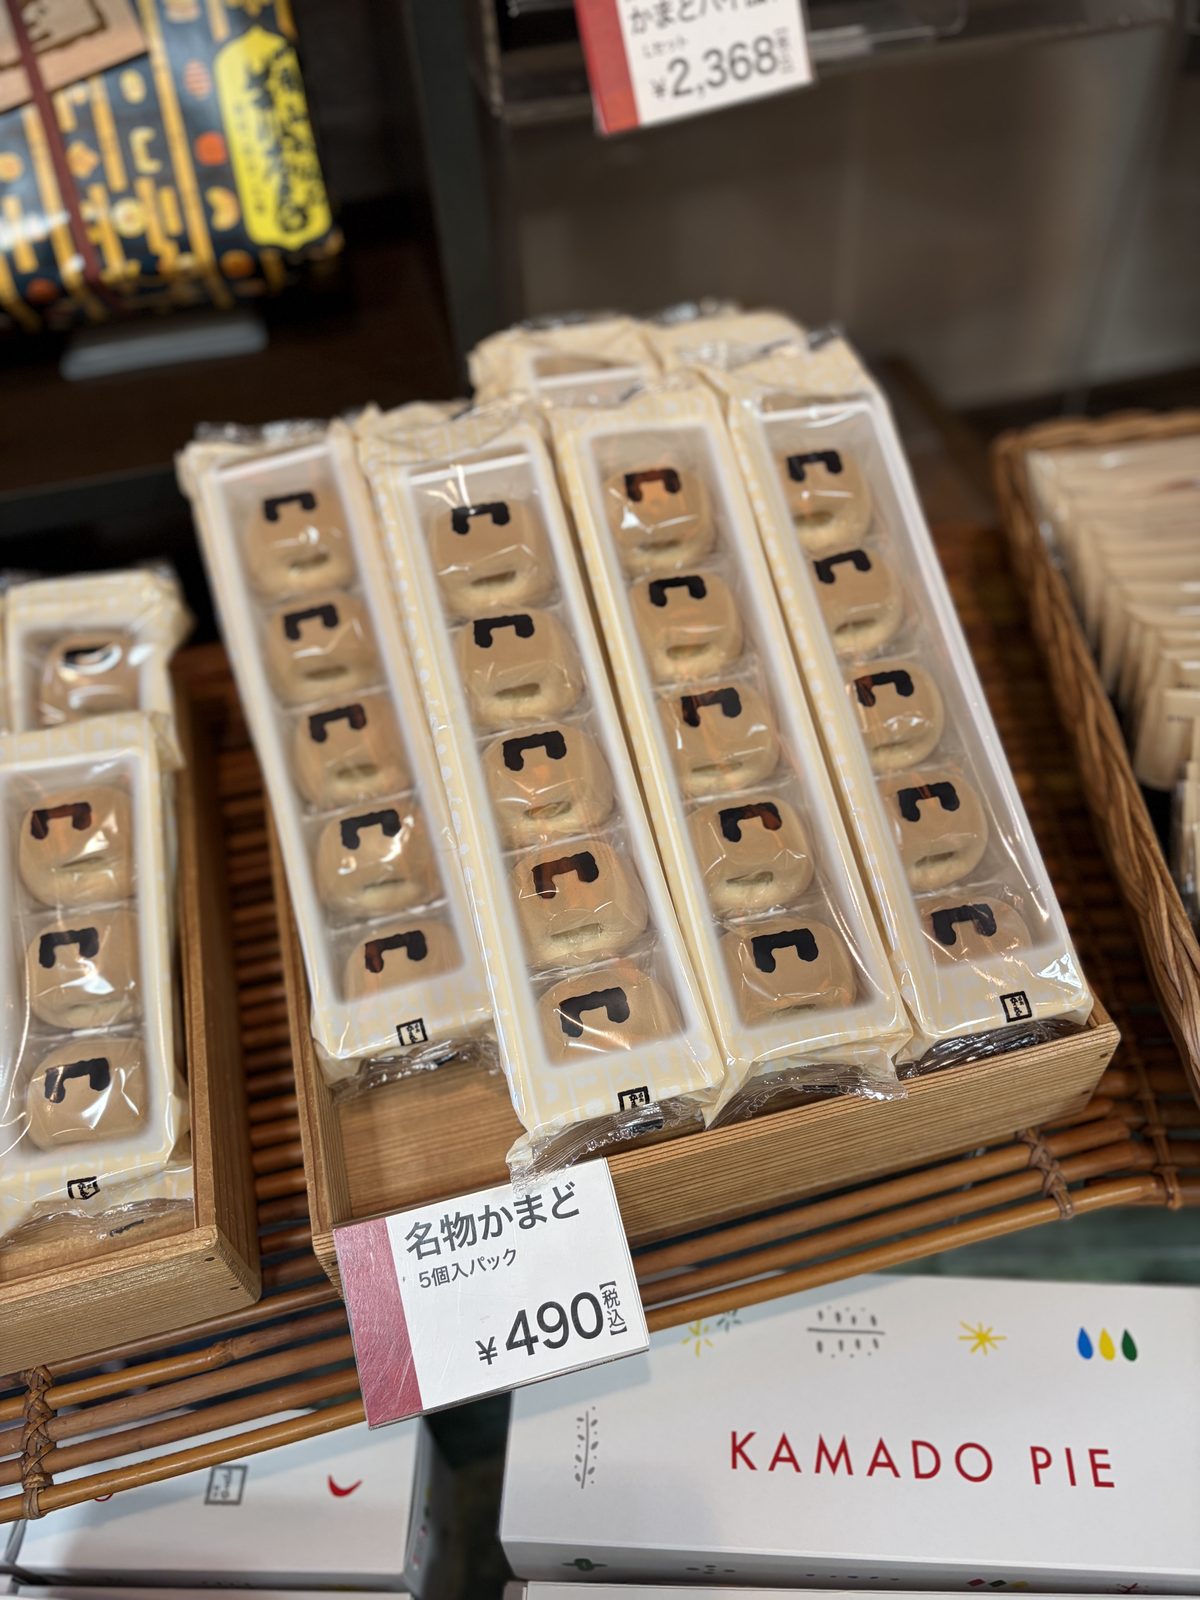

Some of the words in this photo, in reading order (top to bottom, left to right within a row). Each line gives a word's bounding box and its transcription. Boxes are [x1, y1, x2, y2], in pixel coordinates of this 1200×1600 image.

[649, 35, 778, 99] ¥2,368
[404, 1180, 581, 1261] 名物かまど
[419, 1248, 516, 1289] 5個入パック
[731, 1431, 993, 1483] KAMADO
[1029, 1445, 1115, 1488] PIE
